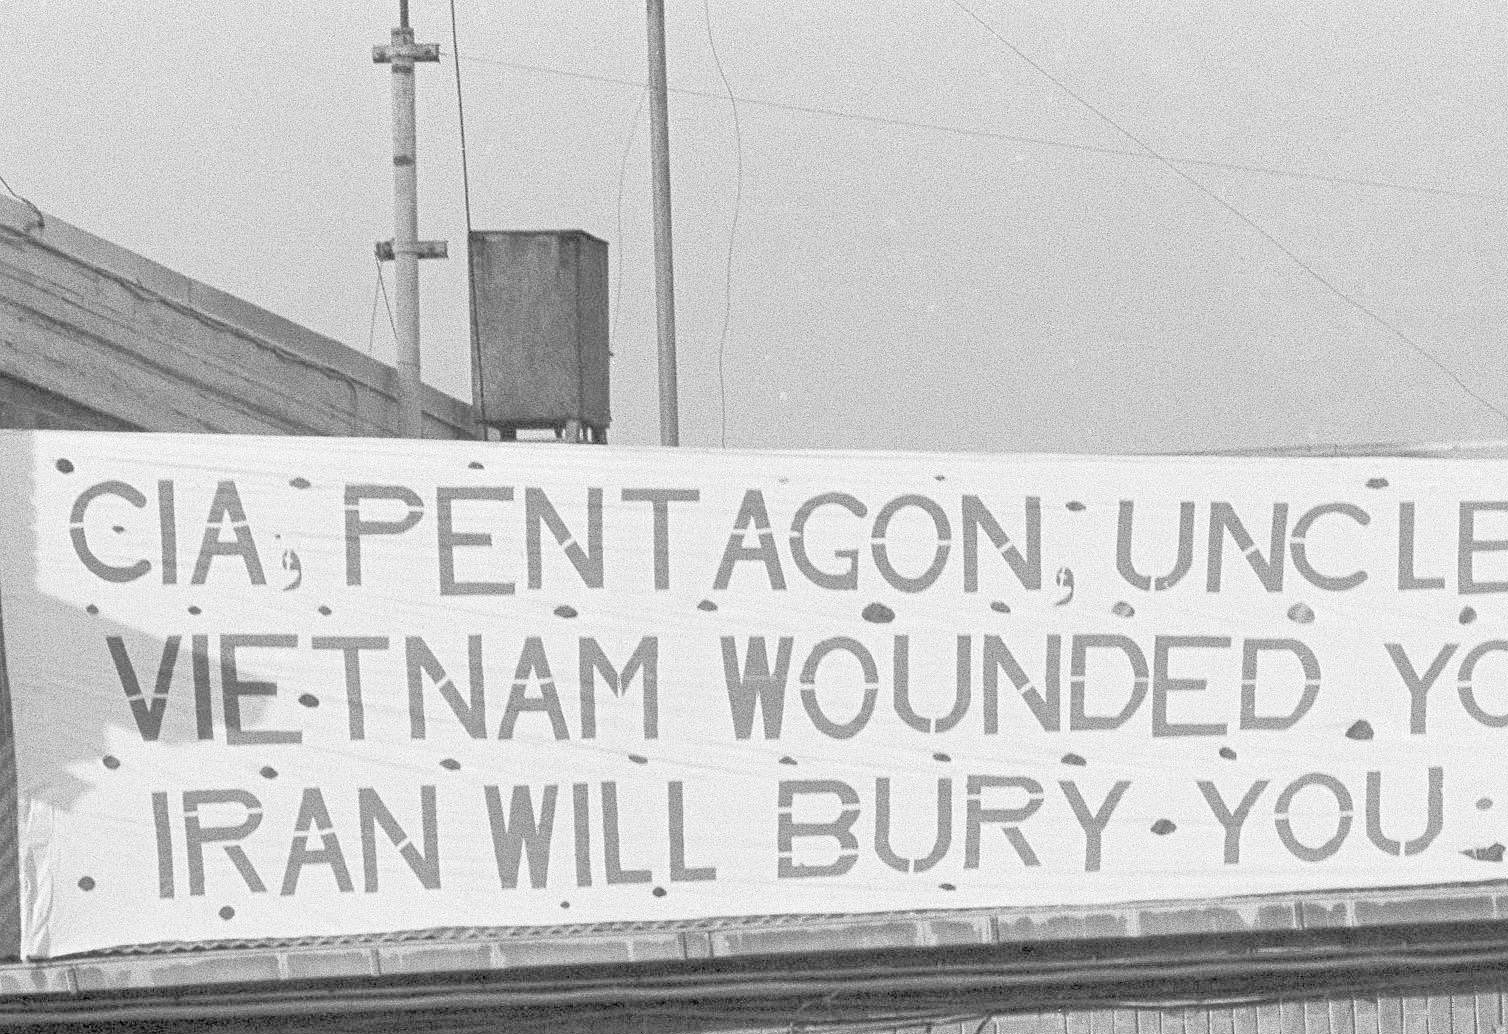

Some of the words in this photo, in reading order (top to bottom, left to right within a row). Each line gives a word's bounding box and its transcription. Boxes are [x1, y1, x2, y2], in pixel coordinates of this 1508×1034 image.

[105, 632, 659, 745] VIETNAM
[718, 632, 1322, 741] WOUNDED
[151, 783, 442, 899] IRAN
[483, 779, 718, 890] WILL
[776, 772, 1132, 880] BURY
[1196, 766, 1445, 867] YOU
